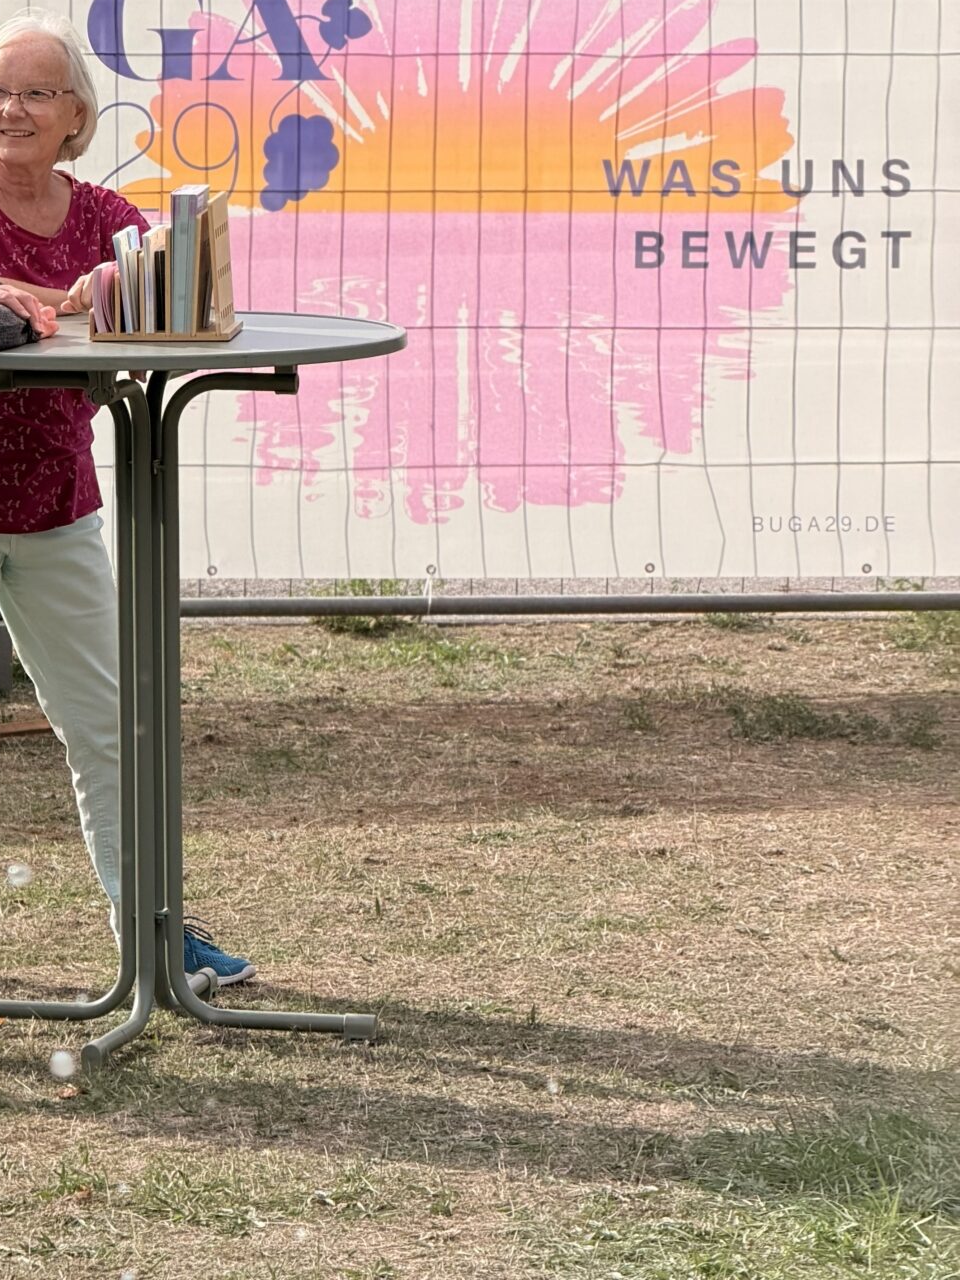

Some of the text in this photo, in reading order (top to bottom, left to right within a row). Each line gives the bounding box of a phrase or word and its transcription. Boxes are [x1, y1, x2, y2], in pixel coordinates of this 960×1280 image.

[602, 158, 913, 199] WAS UNS
[634, 230, 912, 270] BEWEGT
[753, 516, 897, 532] BUGA29.DE
